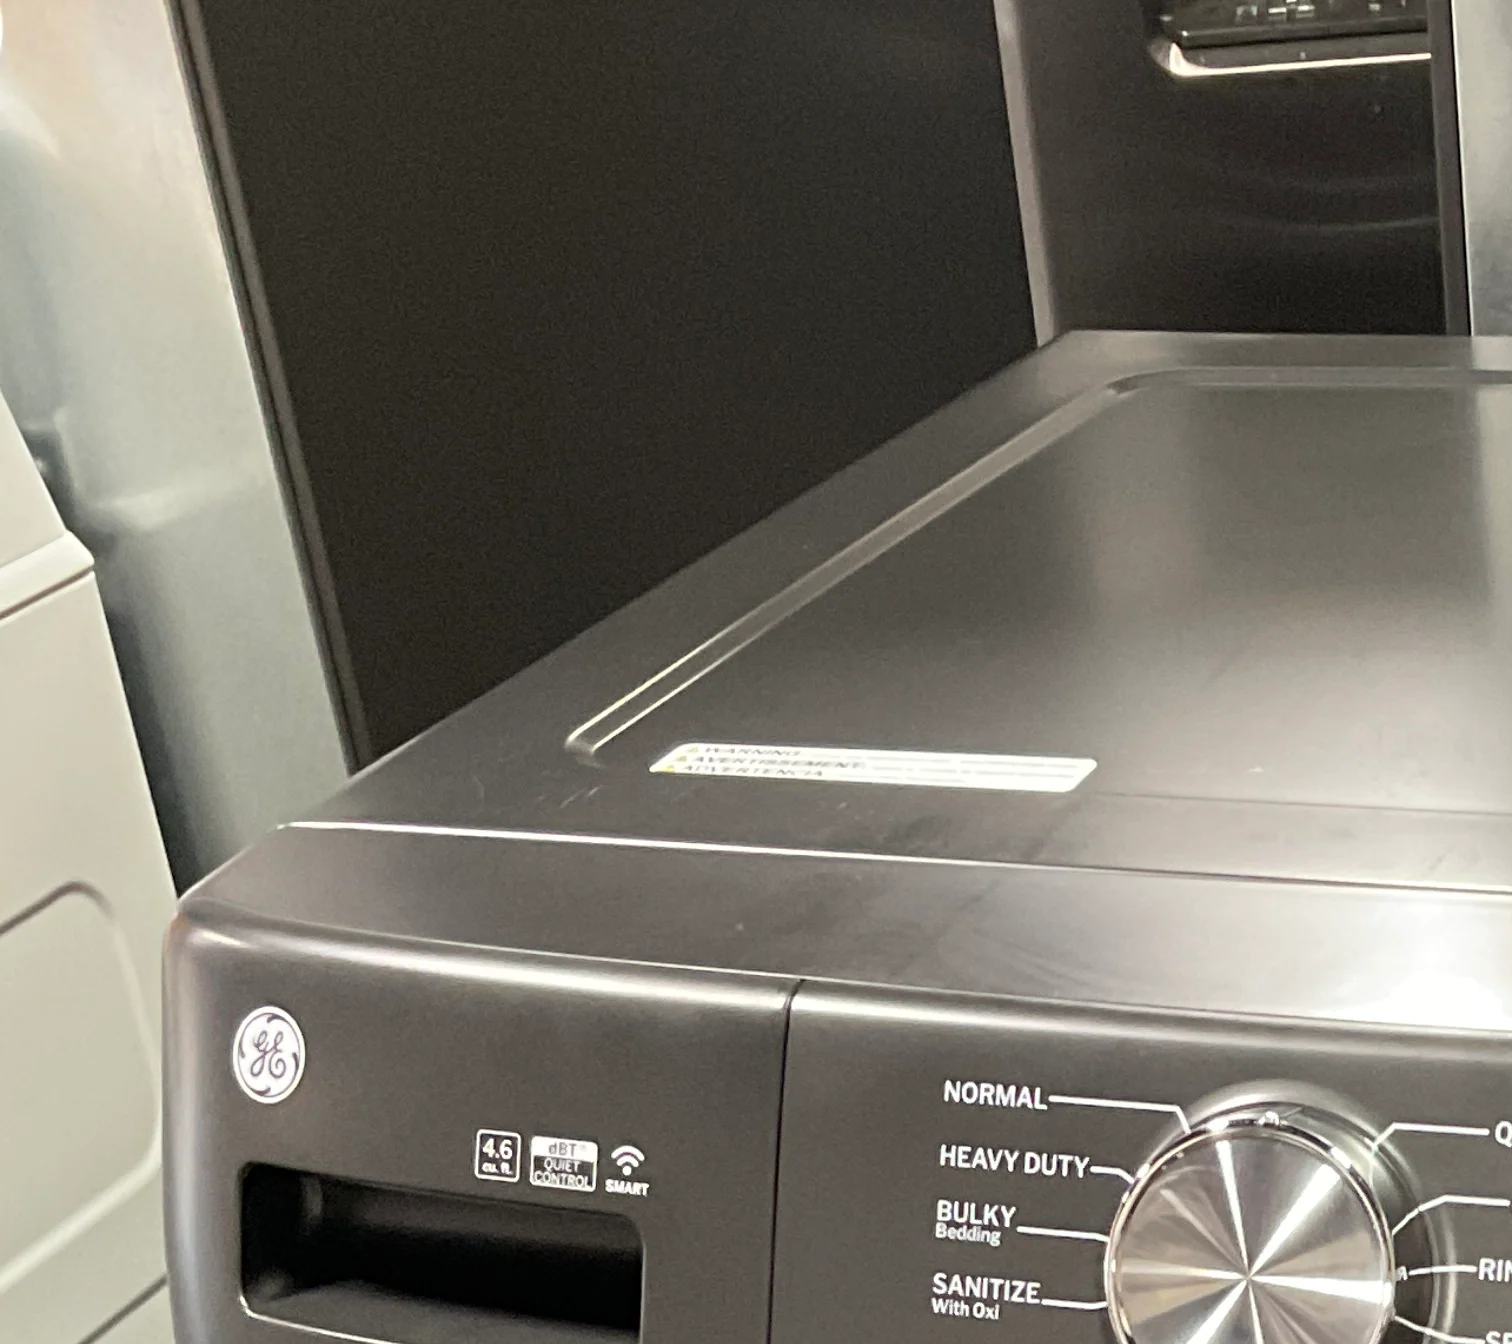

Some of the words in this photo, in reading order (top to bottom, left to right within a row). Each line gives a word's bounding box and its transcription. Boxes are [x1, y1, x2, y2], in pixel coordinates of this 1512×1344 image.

[943, 1079, 1048, 1110] NORMAL
[482, 1138, 513, 1160] 4.6
[544, 1157, 581, 1172] QUIET
[940, 1144, 1020, 1173] HEAVY
[1024, 1151, 1090, 1179] DUTY
[535, 1171, 591, 1188] CONTROL
[605, 1179, 650, 1197] SMART
[936, 1199, 1017, 1228] BULKY
[935, 1222, 1002, 1247] Bedding
[932, 1272, 1041, 1304] SANITIZE
[931, 1297, 969, 1317] With
[972, 1302, 1001, 1321] Oxi
